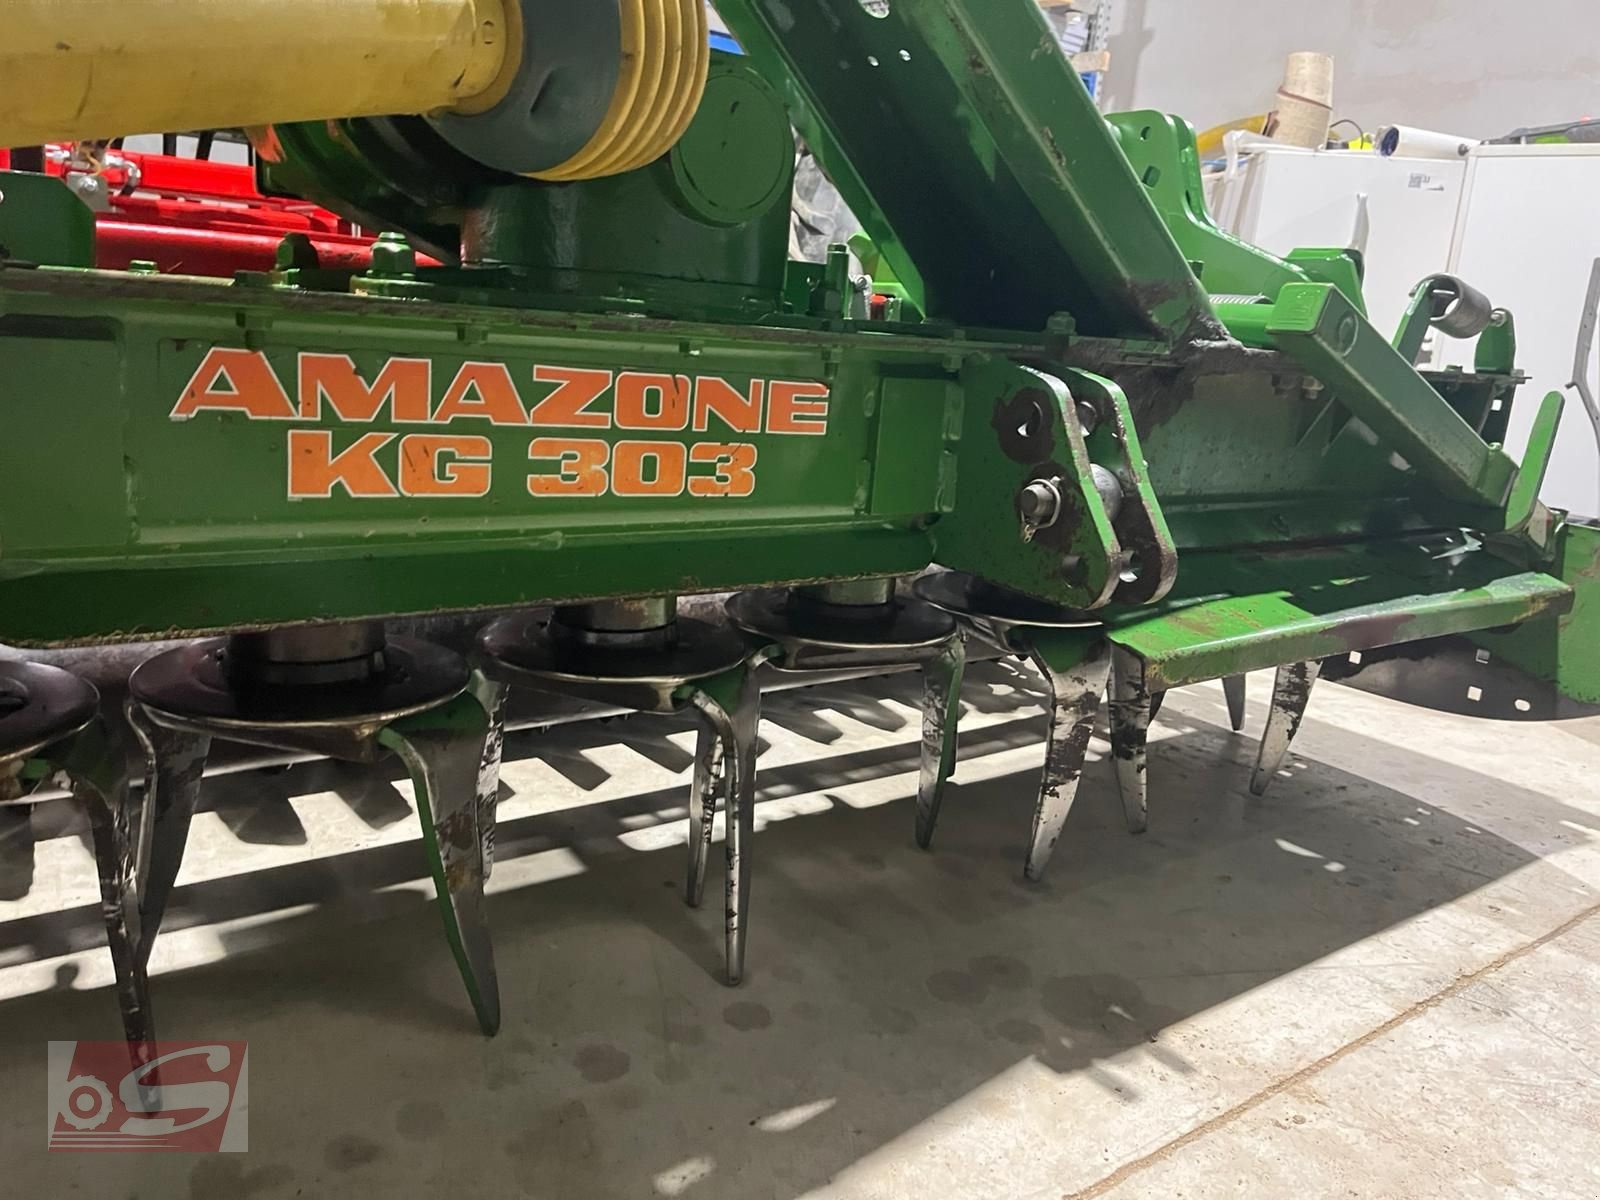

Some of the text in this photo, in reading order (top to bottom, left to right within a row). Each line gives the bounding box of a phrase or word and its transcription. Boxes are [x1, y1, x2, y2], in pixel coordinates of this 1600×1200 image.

[169, 347, 830, 435] AMAZONE
[287, 430, 757, 499] KG 303
